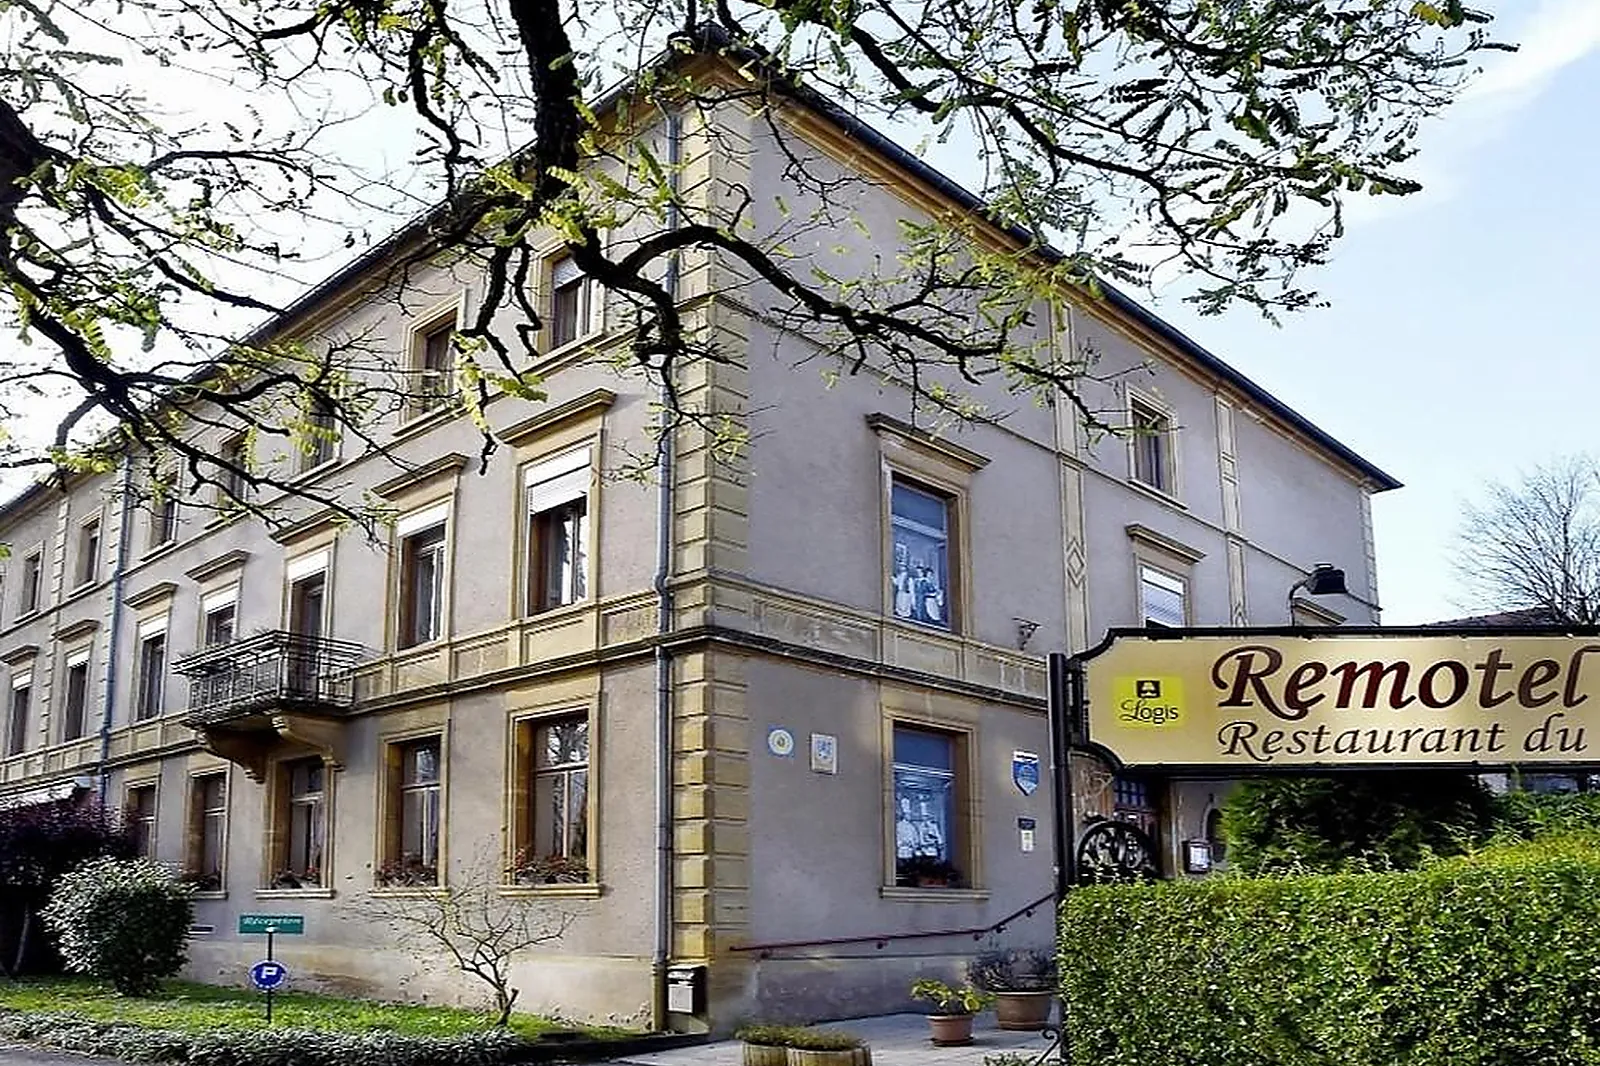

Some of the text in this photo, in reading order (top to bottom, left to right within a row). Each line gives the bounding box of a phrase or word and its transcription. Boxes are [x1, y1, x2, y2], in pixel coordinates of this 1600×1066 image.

[1212, 645, 1600, 720] Remotel
[1119, 697, 1178, 724] Logis
[1218, 713, 1588, 762] Restaurant du
[261, 966, 278, 979] P
